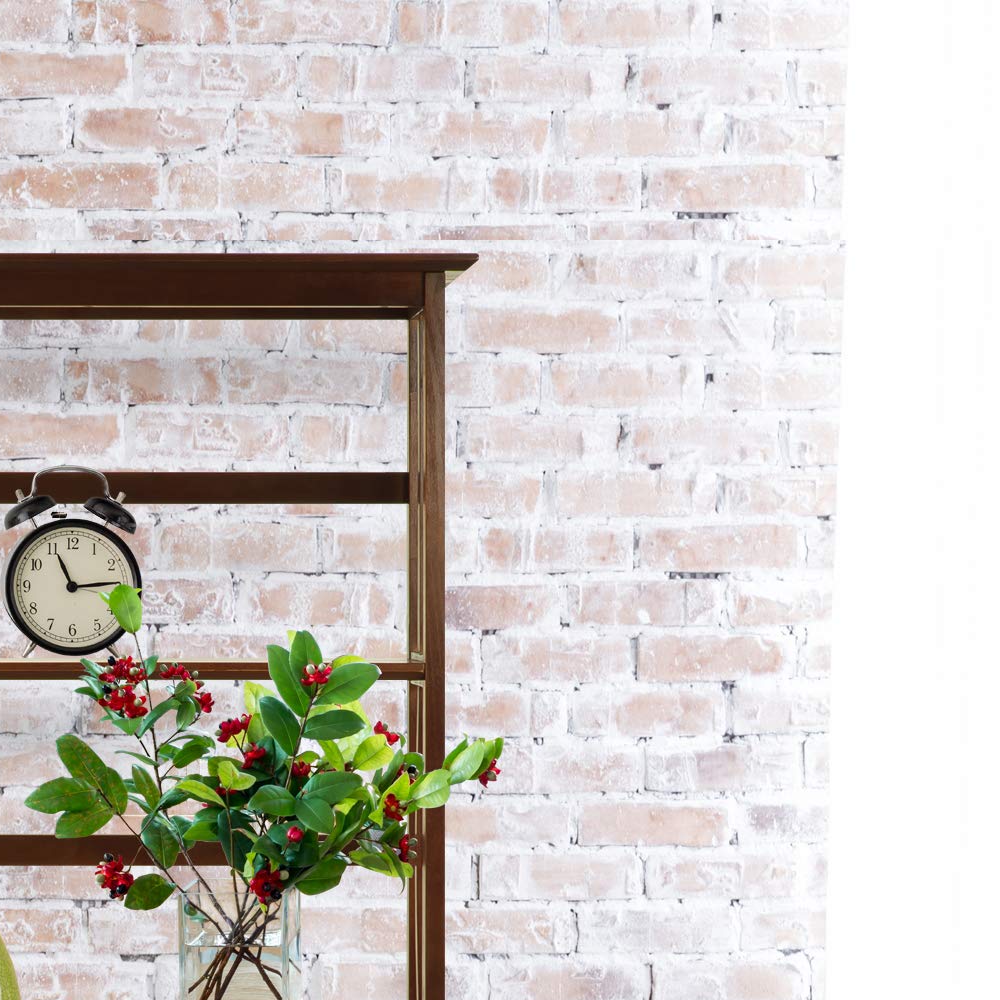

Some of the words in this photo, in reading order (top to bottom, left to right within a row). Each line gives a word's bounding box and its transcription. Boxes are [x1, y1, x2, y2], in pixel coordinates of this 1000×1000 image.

[47, 542, 58, 555] 11
[66, 537, 79, 550] 12
[30, 559, 43, 571] 10
[107, 558, 116, 571] 2
[23, 579, 31, 593] 9
[29, 602, 38, 615] 8
[47, 618, 55, 631] 7
[68, 624, 77, 636] 6
[93, 619, 101, 631] 5
